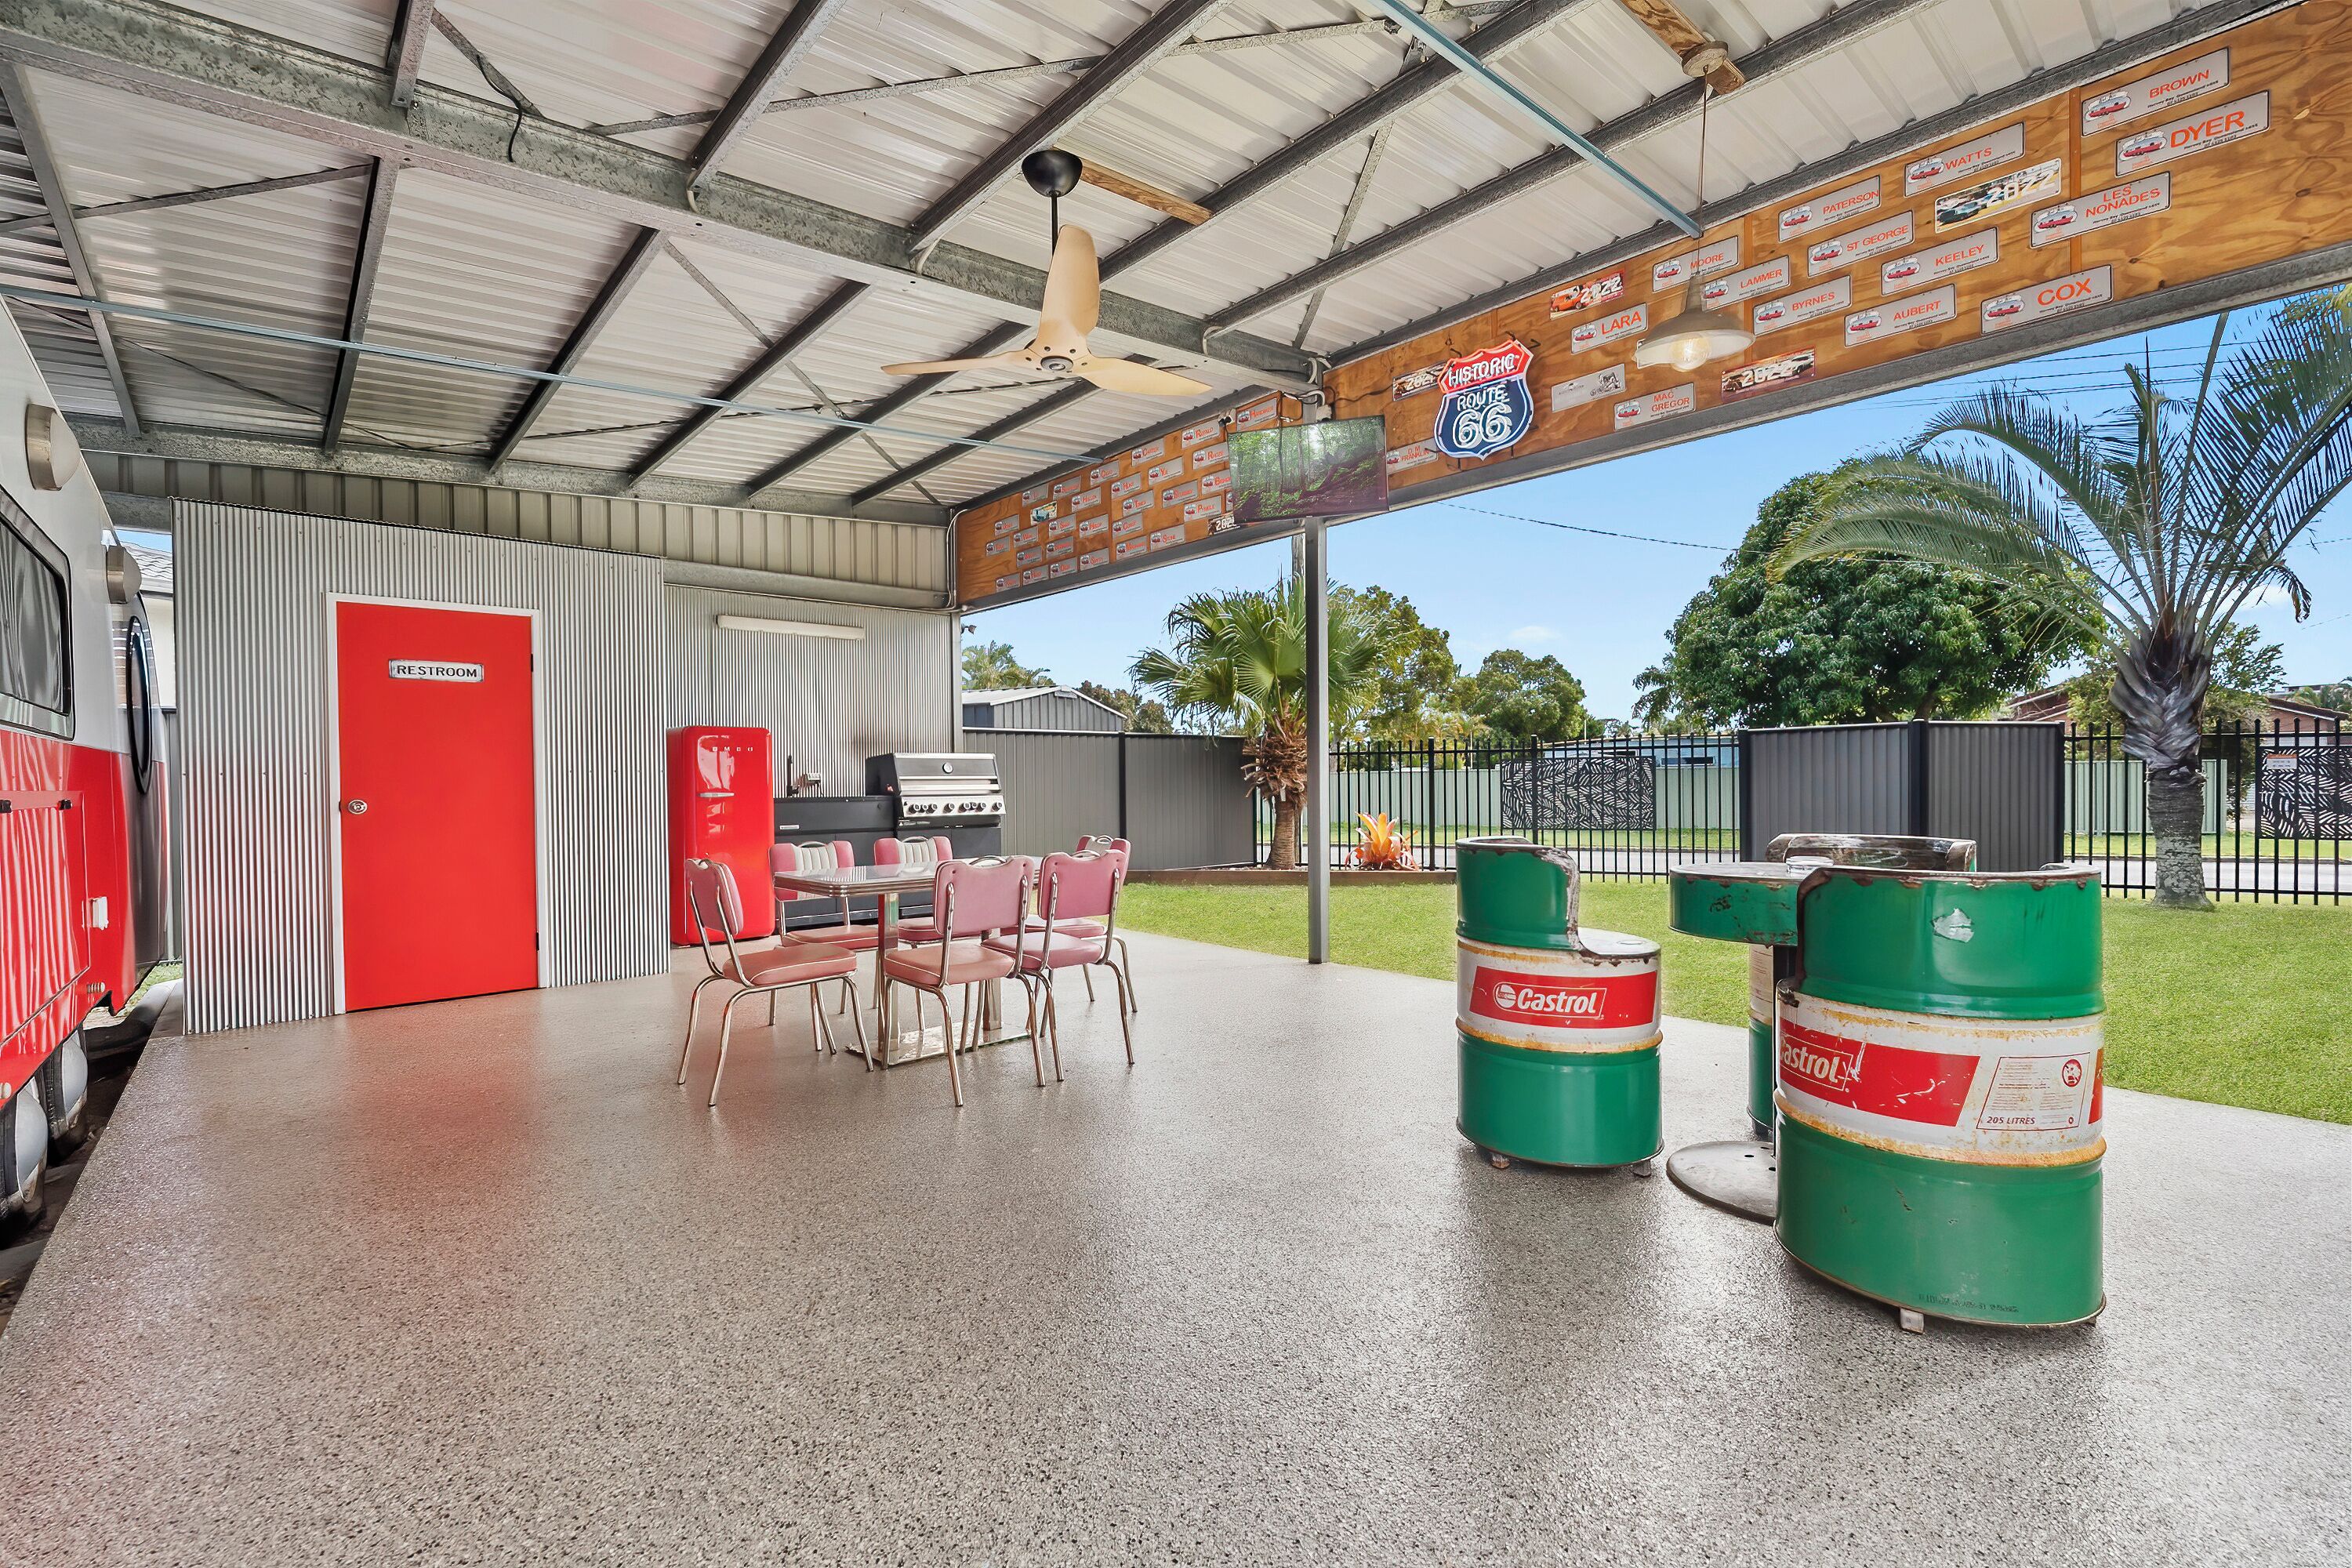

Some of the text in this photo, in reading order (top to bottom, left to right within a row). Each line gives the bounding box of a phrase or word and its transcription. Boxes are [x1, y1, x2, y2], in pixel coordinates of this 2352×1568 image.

[2149, 69, 2210, 99] BROWN
[2170, 111, 2245, 147] DYER
[1946, 147, 1992, 170] WATTS
[1986, 169, 2056, 205] 2022
[2103, 184, 2132, 202] LES
[1823, 190, 1879, 215] PATERSON
[2085, 187, 2160, 218] NONADES
[1846, 225, 1908, 252] ST GEORGE
[1690, 252, 1724, 269] MOORE
[1935, 244, 1984, 267] KEELEY
[1740, 268, 1782, 289] LAMMER
[1792, 292, 1835, 311] BYRNES
[2038, 278, 2092, 306] COX
[1600, 310, 1642, 335] LARA
[1893, 300, 1941, 321] AUBERT
[1448, 353, 1519, 387] HISTORIC
[1457, 385, 1509, 411] ROUTE
[1651, 397, 1690, 412] GREGOR
[1653, 391, 1674, 402] MAC
[1452, 401, 1512, 448] 66
[397, 665, 477, 678] RESTROOM
[1517, 988, 1597, 1014] Castrol
[1987, 1116, 2035, 1125] 205 LITRES
